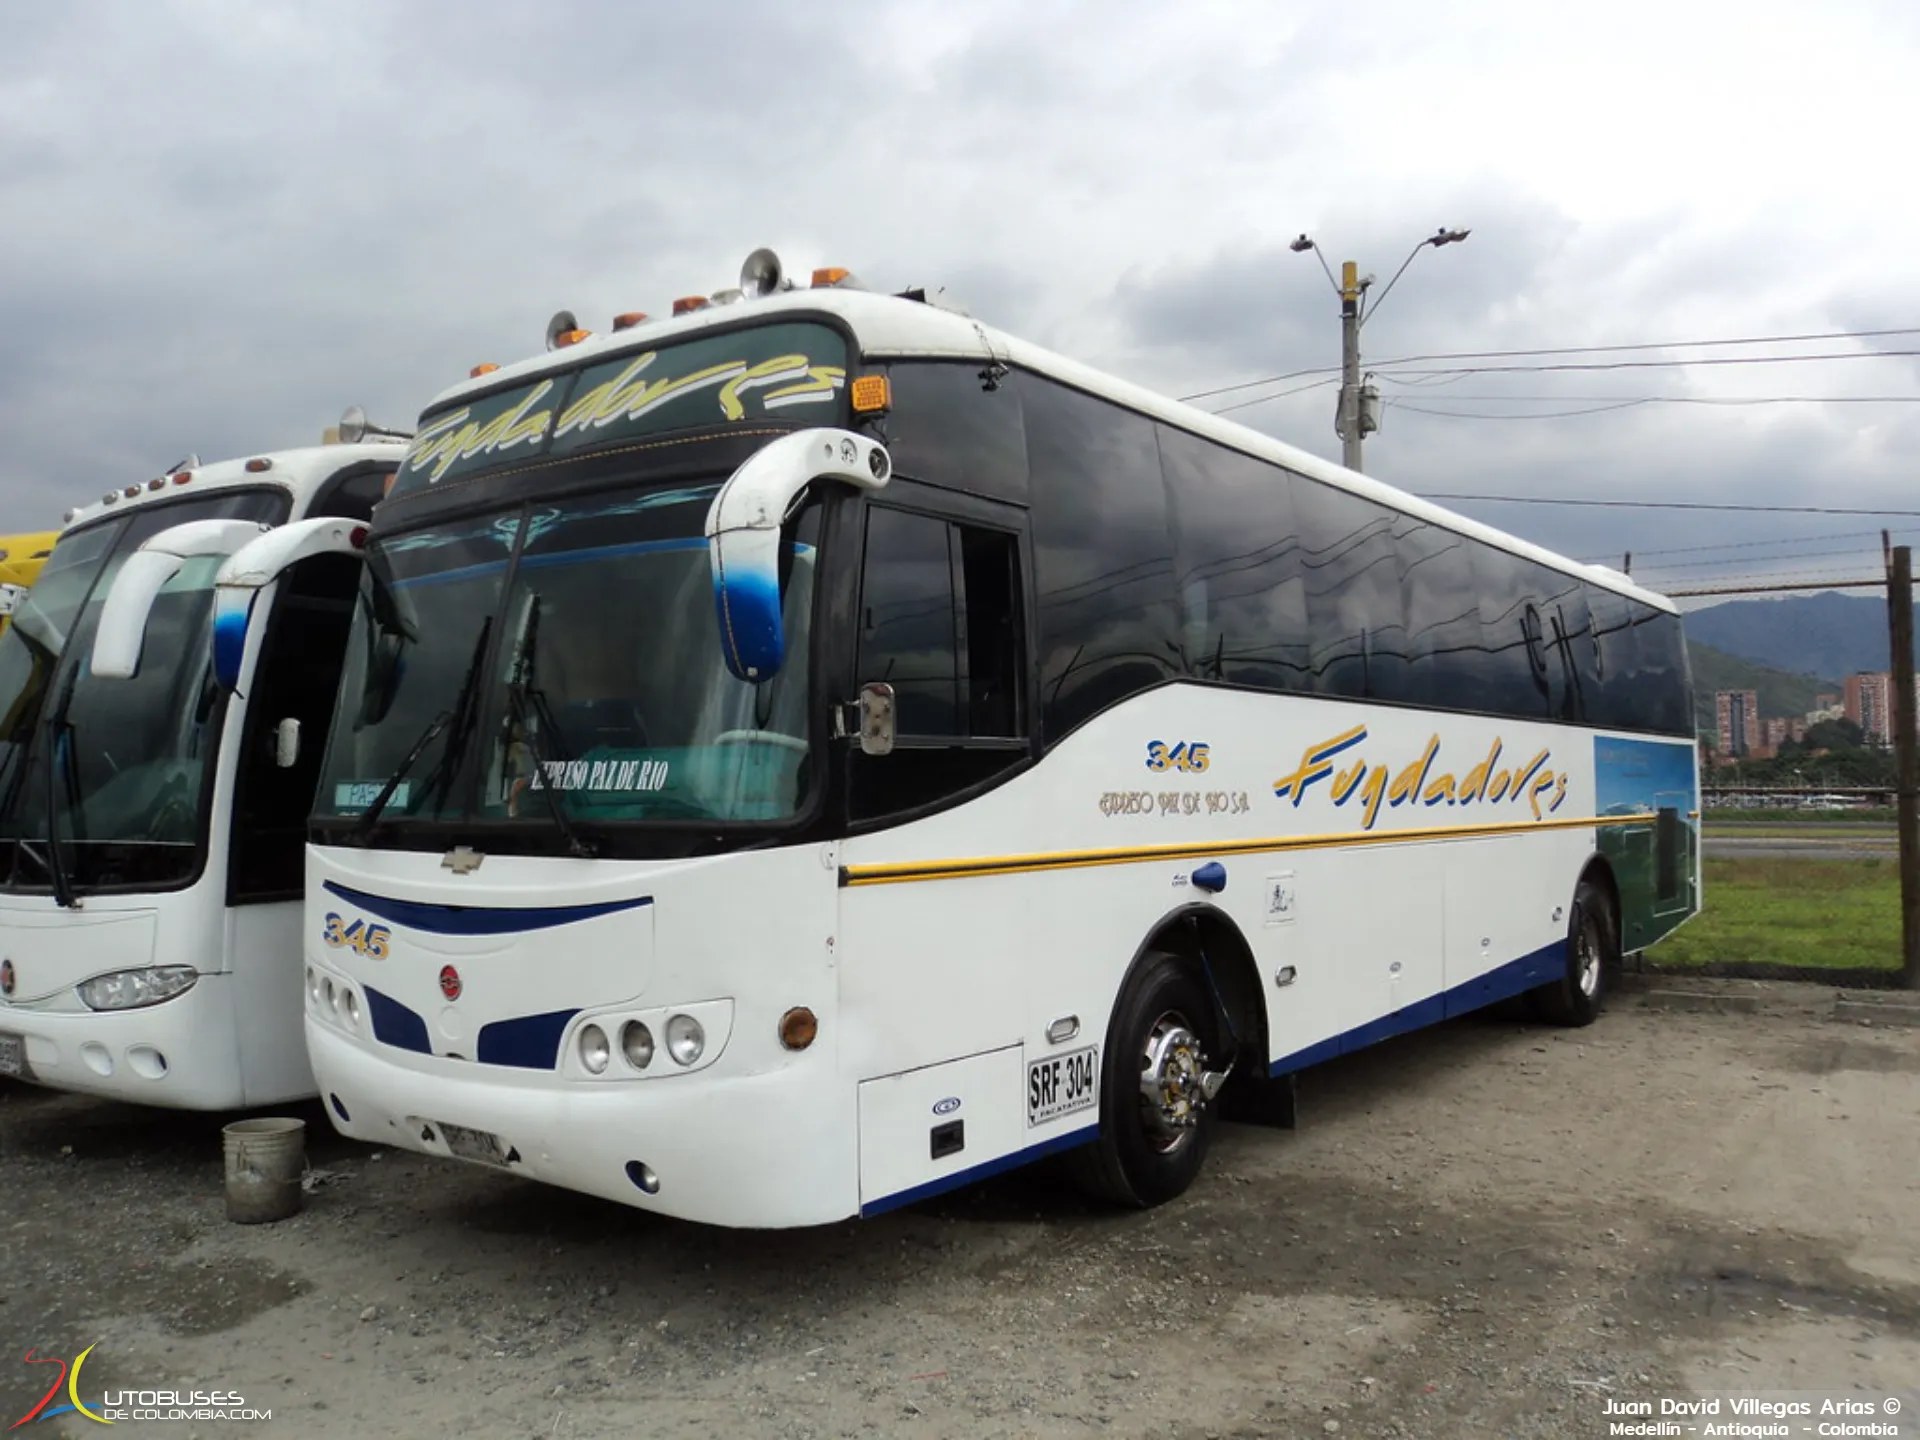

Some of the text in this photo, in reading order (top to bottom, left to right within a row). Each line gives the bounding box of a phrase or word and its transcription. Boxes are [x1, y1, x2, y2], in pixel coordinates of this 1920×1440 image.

[588, 760, 618, 790] PAZ
[614, 760, 640, 790] DE
[635, 759, 669, 791] RIO
[1145, 740, 1210, 773] 345
[323, 911, 392, 961] 345
[1030, 1052, 1092, 1109] SRF 304
